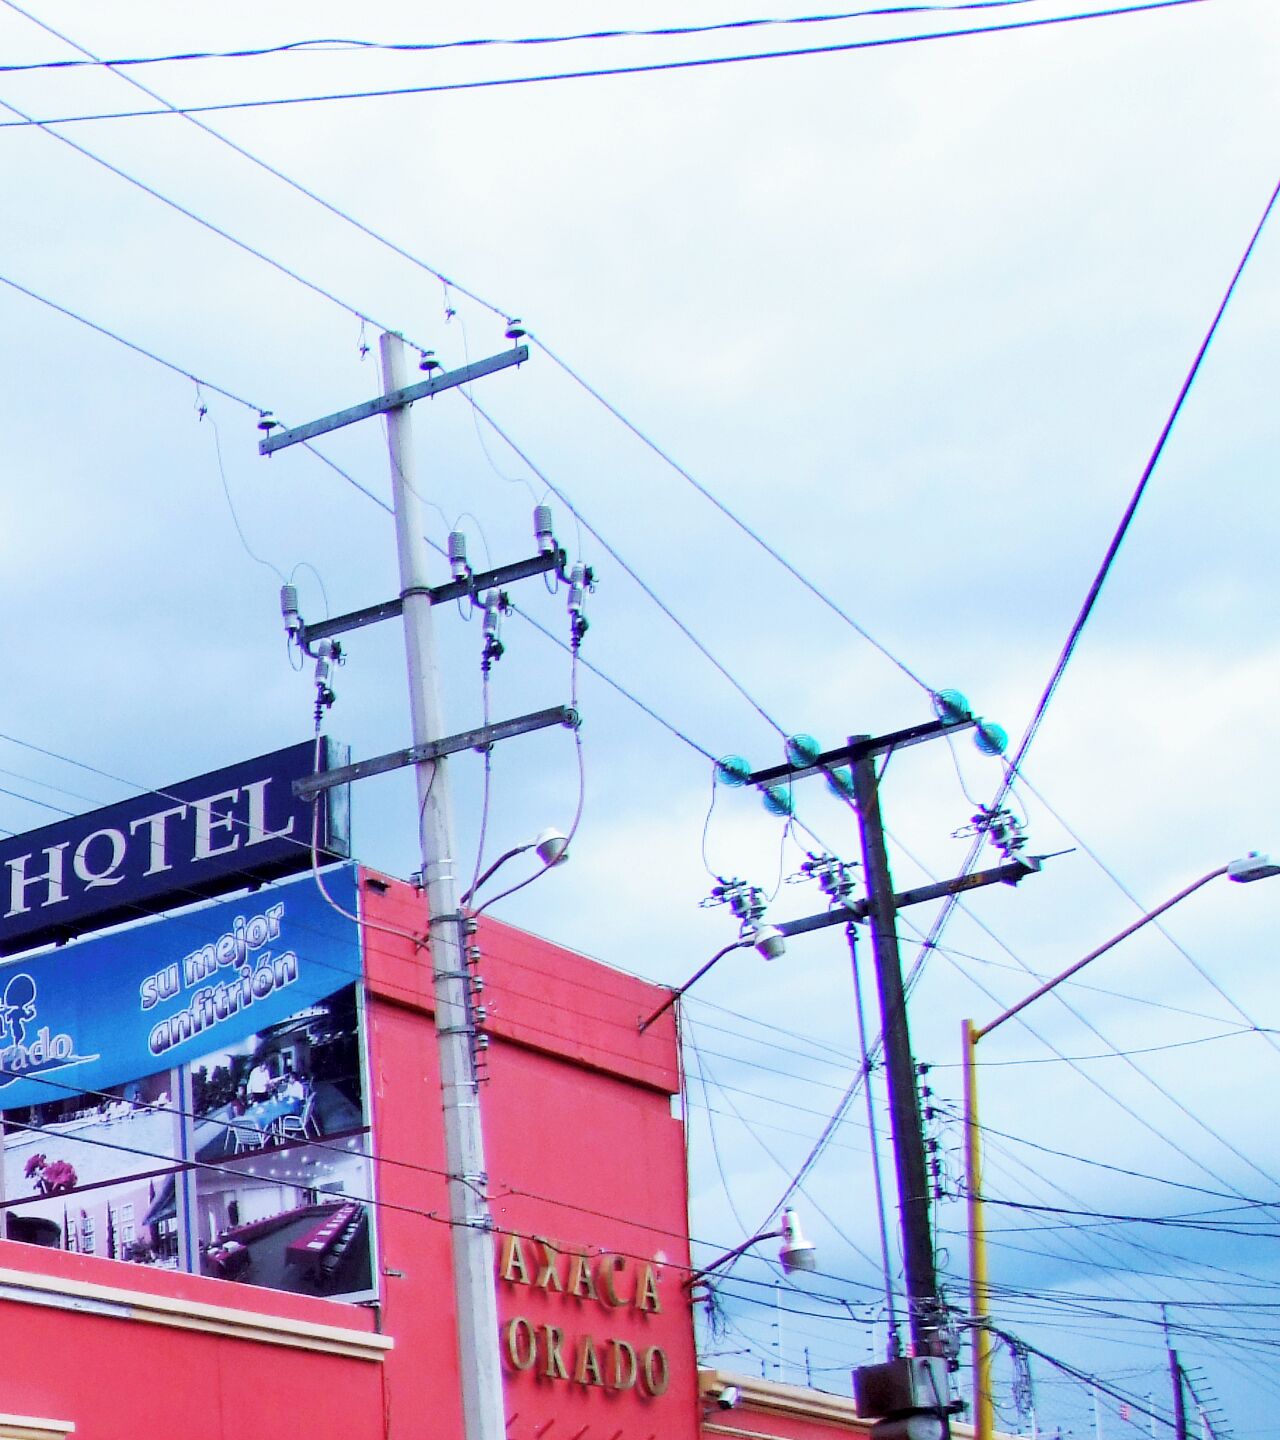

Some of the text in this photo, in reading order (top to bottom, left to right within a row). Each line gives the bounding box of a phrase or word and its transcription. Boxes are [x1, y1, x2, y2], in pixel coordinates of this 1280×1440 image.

[4, 777, 295, 919] HOTEL
[140, 902, 284, 1010] su mejor
[148, 951, 298, 1056] anfitrión
[500, 1233, 662, 1314] AXACA
[505, 1316, 669, 1396] ORADO
